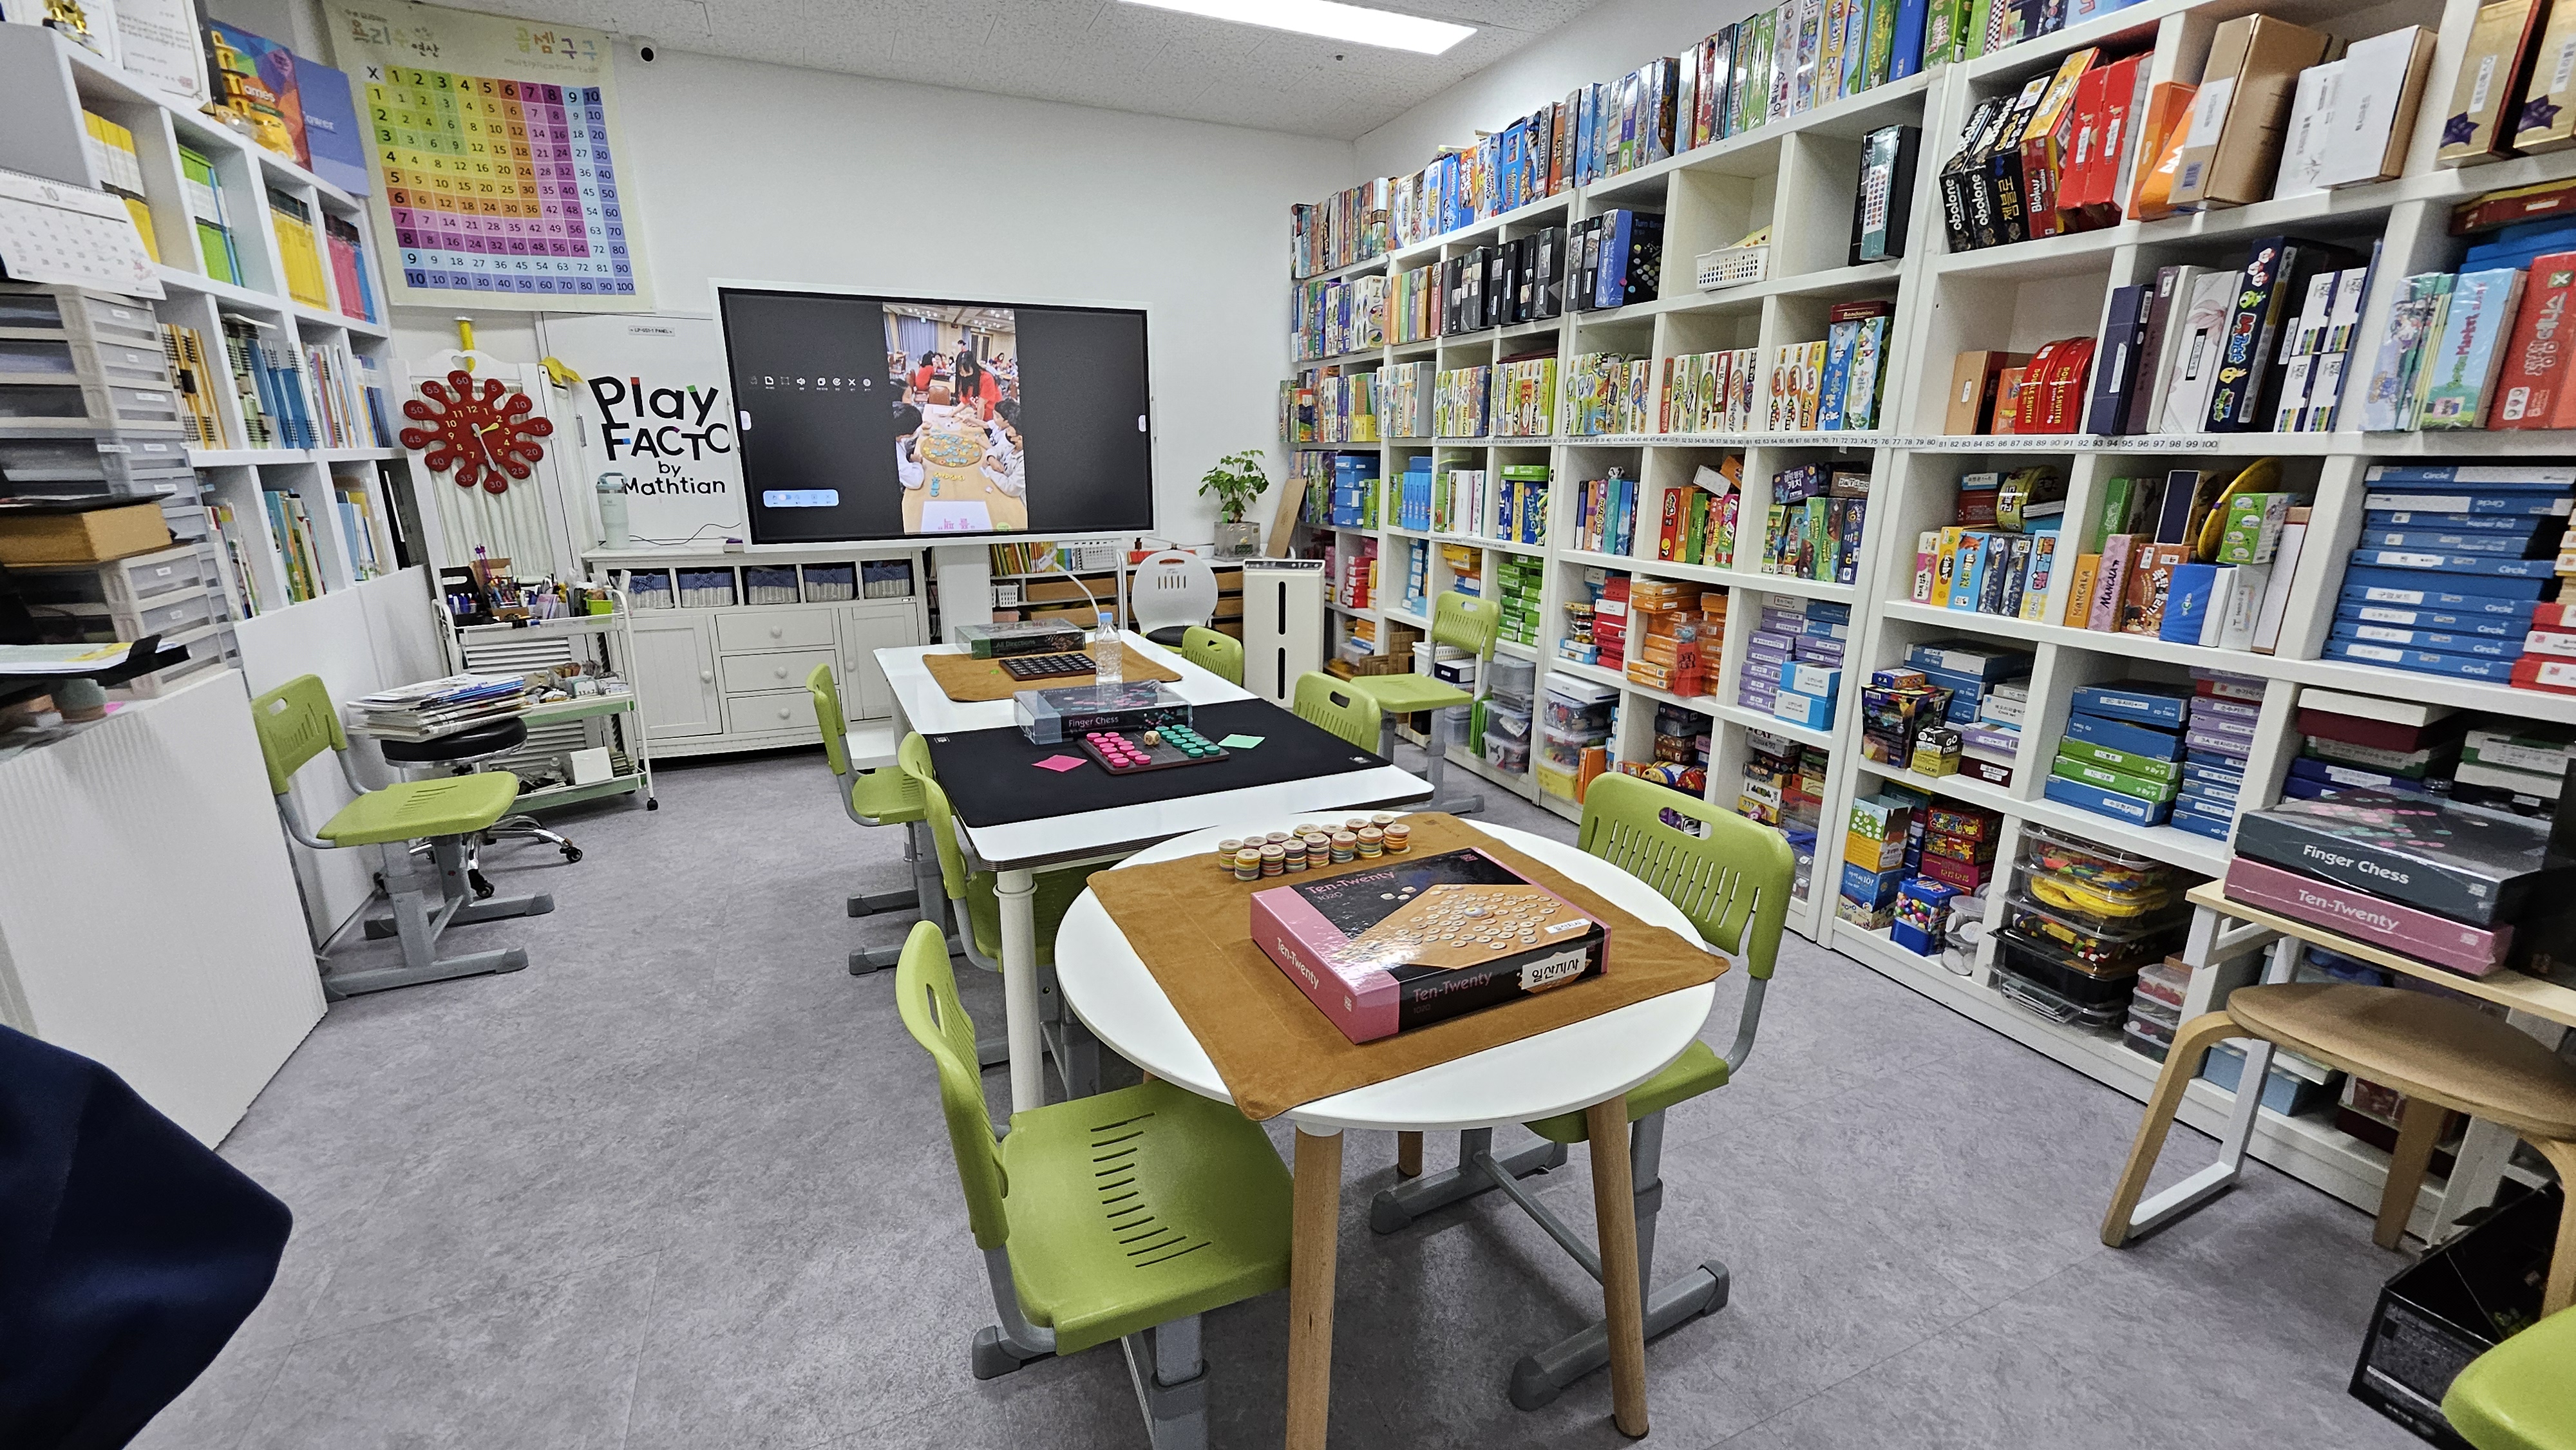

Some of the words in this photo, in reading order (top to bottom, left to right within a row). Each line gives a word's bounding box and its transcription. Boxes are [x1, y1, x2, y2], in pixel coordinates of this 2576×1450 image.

[374, 88, 381, 100] 1
[392, 70, 400, 82] 1
[413, 73, 424, 85] 2
[437, 76, 447, 89] 3
[460, 79, 470, 91] 4
[483, 82, 492, 93] 5
[504, 84, 515, 97] 6
[526, 86, 535, 99] 7
[547, 88, 557, 101] 8
[569, 91, 578, 103] 9
[583, 90, 600, 102] 10
[377, 108, 388, 122] 2
[1984, 97, 2017, 146] abalone
[381, 129, 392, 142] 3
[386, 151, 396, 162] 4
[390, 171, 400, 183] 5
[394, 191, 405, 204] 6
[1946, 178, 1962, 231] abalone
[1971, 174, 1989, 225] abalone
[1998, 176, 2020, 221] 젬블로
[2030, 179, 2043, 213] Blokus
[398, 212, 408, 223] 7
[402, 232, 413, 245] 8
[408, 253, 417, 264] 9
[430, 255, 438, 264] 9
[450, 257, 464, 266] 18
[472, 259, 485, 267] 27
[494, 260, 507, 269] 36
[515, 261, 528, 270] 45
[536, 261, 548, 270] 54
[556, 262, 569, 271] 63
[576, 263, 589, 272] 72
[596, 264, 609, 272] 81
[616, 264, 629, 273] 90
[408, 272, 426, 285] 10
[432, 275, 446, 284] 10
[454, 276, 468, 285] 20
[477, 278, 489, 287] 30
[498, 279, 511, 288] 40
[519, 280, 532, 289] 50
[540, 281, 553, 289] 60
[560, 281, 573, 290] 70
[580, 282, 592, 290] 80
[600, 282, 612, 291] 90
[616, 283, 634, 291] 100
[456, 377, 469, 385] 60
[2029, 368, 2041, 394] DOULE
[2057, 366, 2070, 394] DOULE
[426, 386, 439, 394] 55
[587, 376, 719, 427] Play
[2025, 396, 2034, 424] SHUTTER
[2054, 395, 2063, 424] SHUTTER
[460, 474, 473, 482] 35
[511, 467, 524, 475] 25
[658, 461, 681, 478] by
[2422, 471, 2450, 480] Circle
[622, 478, 726, 496] Mathtian
[2498, 565, 2528, 575] Circle
[2071, 570, 2092, 618] MANCALA
[2485, 604, 2514, 614] Circle
[2477, 625, 2506, 634] Circle
[2473, 645, 2502, 654] Circle
[2461, 664, 2490, 675] Circle
[1068, 718, 1094, 729] Finger
[1095, 715, 1119, 726] Chess
[1946, 735, 1958, 746] GO
[2302, 843, 2356, 869] Finger
[2357, 859, 2410, 885] Chess
[1305, 869, 1396, 896] Ten-Twenty
[1316, 890, 1343, 902] 1020
[2298, 889, 2400, 931] Ten-Twenty
[1276, 936, 1320, 990] Ten-Twenty
[1531, 957, 1580, 983] 일산지사
[1412, 970, 1493, 1003] Ten-Twenty
